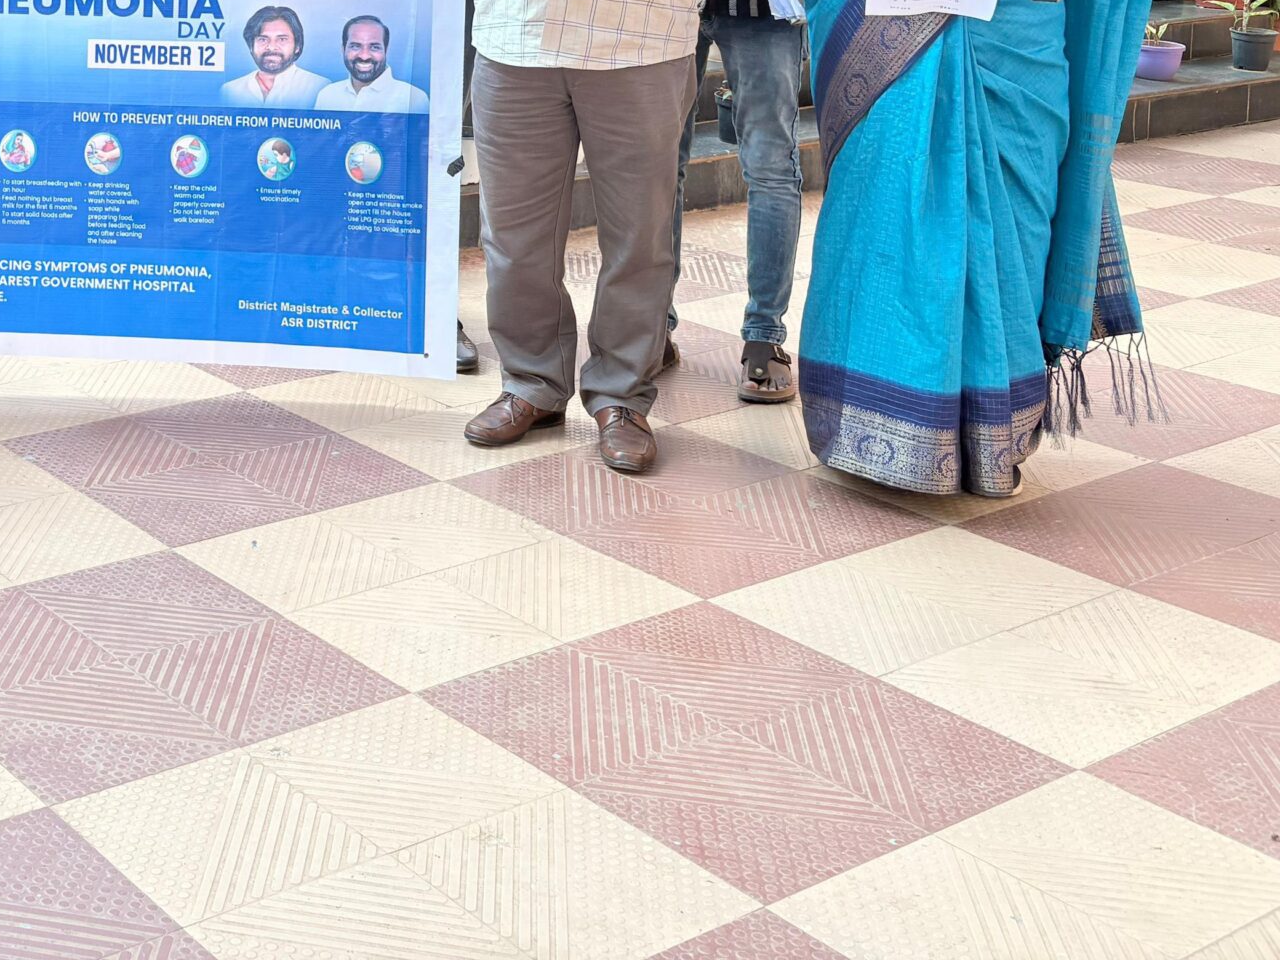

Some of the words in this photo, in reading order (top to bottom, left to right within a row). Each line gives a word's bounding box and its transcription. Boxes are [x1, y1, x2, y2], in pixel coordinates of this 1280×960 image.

[177, 21, 225, 40] DAY
[95, 44, 191, 66] NOVEMBER
[198, 46, 216, 67] 12
[73, 111, 101, 123] HOW
[103, 112, 118, 124] TO
[121, 113, 173, 125] PREVENT
[176, 114, 232, 127] CHILDREN
[236, 116, 268, 128] FROM
[272, 118, 341, 130] PNEUMONIA
[26, 180, 68, 188] breastfeeding
[105, 182, 130, 190] drinking
[282, 188, 301, 196] timely
[348, 191, 364, 199] Keep
[377, 192, 404, 200] windows
[18, 195, 40, 203] nothing
[348, 200, 364, 208] open
[392, 209, 411, 217] house
[88, 214, 117, 222] preparing
[108, 222, 131, 230] feeding
[347, 224, 372, 232] cooking
[382, 225, 399, 233] avoid
[116, 231, 142, 239] cleaning
[34, 261, 108, 273] SYMPTOMS
[110, 263, 127, 274] OF
[130, 264, 212, 279] PNEUMONIA,
[41, 276, 131, 290] GOVERNMENT
[133, 279, 195, 292] HOSPITAL
[238, 300, 277, 311] District
[280, 302, 338, 315] Magistrate
[341, 305, 350, 315] &
[353, 305, 403, 319] Collector
[281, 317, 303, 328] ASR
[306, 318, 358, 331] DISTRICT
